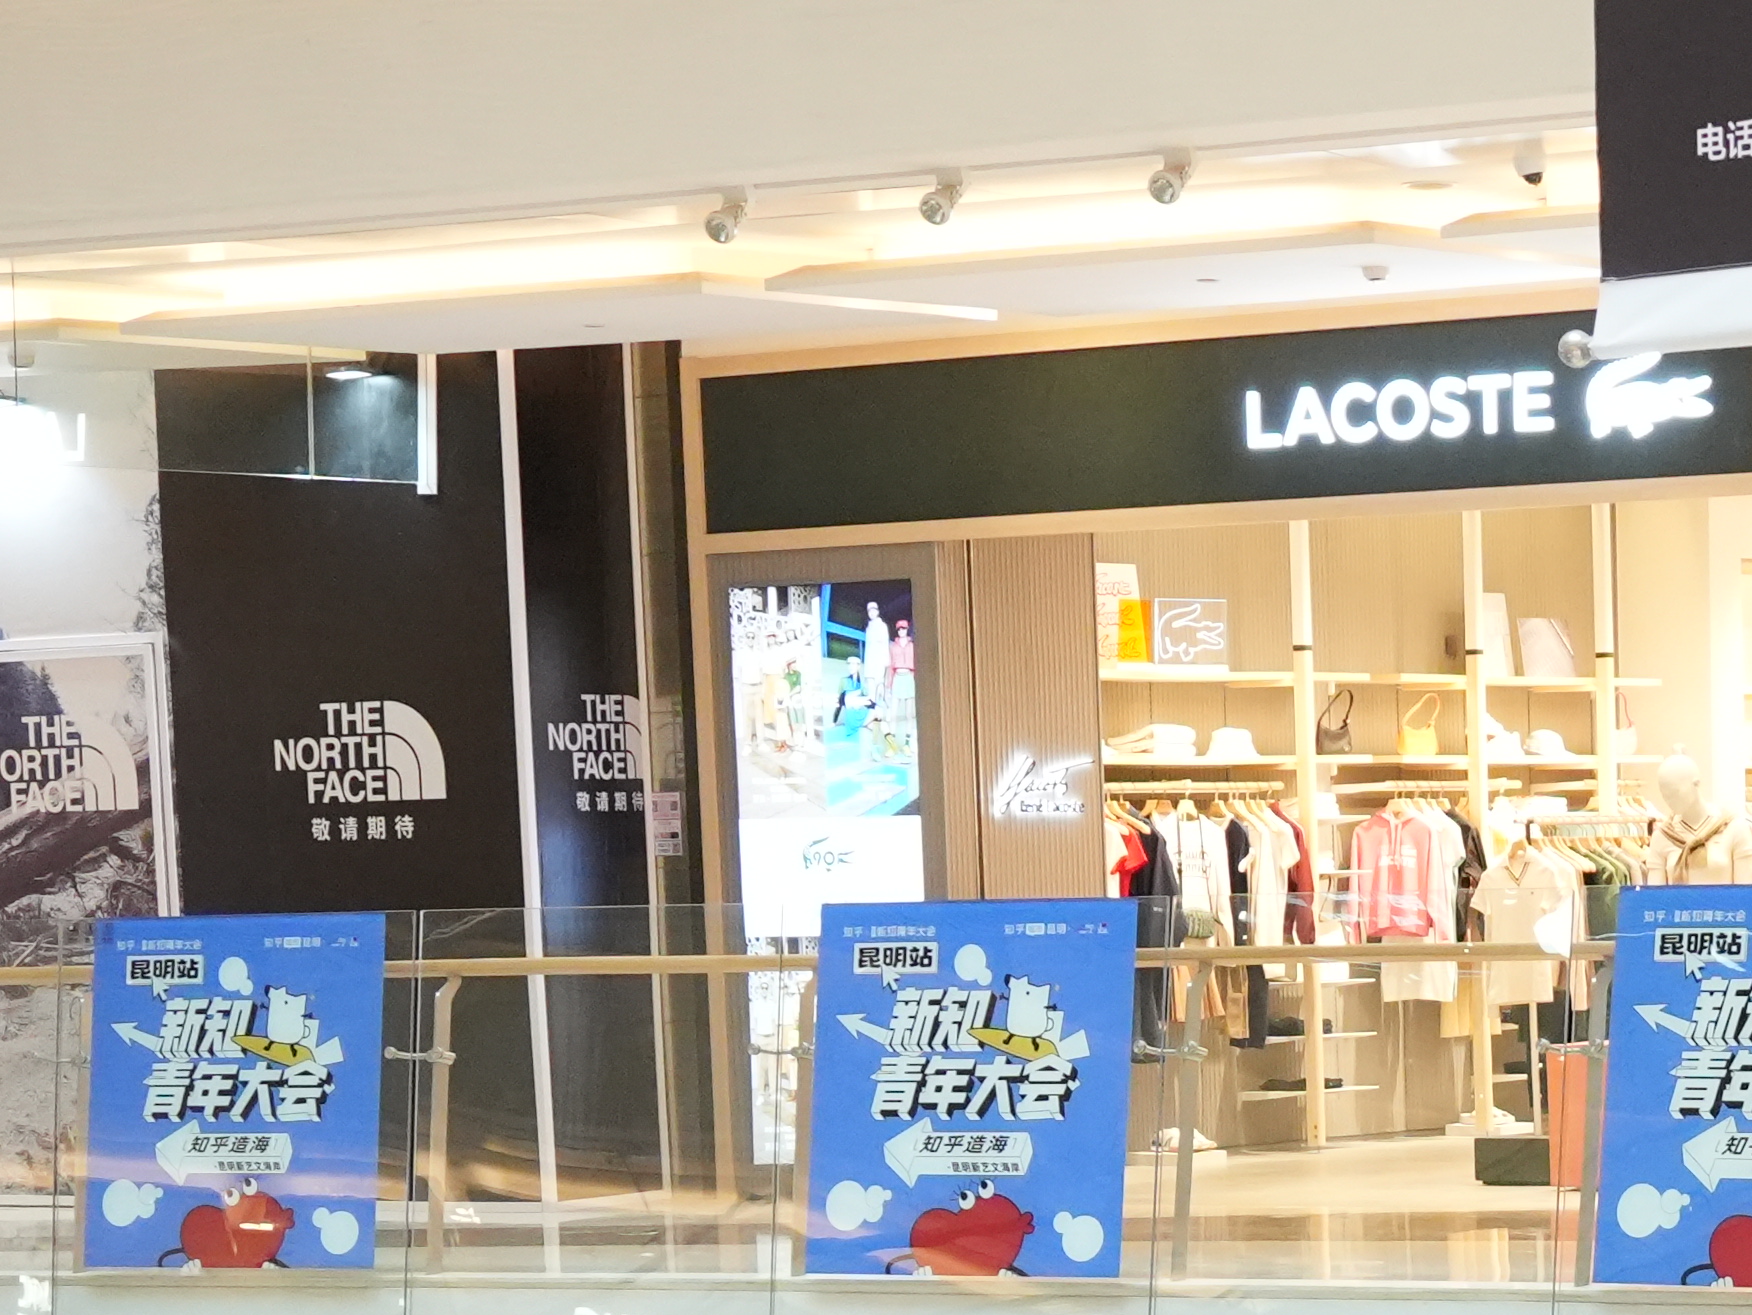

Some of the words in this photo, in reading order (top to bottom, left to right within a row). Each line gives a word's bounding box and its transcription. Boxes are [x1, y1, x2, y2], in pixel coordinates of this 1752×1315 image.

[1245, 370, 1555, 450] LACOSTE
[319, 702, 384, 736] THE
[581, 693, 625, 722] THE
[21, 716, 80, 747] THE
[548, 721, 626, 754] NORTH
[273, 734, 384, 773] NORTH
[572, 751, 627, 780] FACE
[11, 780, 82, 813] FACE
[306, 769, 385, 805] FACE
[576, 790, 644, 812] 敬请期待
[311, 815, 414, 842] 敬请期待
[857, 947, 934, 969] 昆明站
[1659, 932, 1743, 955] 昆明站
[130, 960, 199, 979] 昆明站
[154, 997, 253, 1058] 新知
[884, 987, 992, 1052] 新知
[142, 1060, 330, 1122] 青年大会
[870, 1054, 1074, 1121] 青年大会
